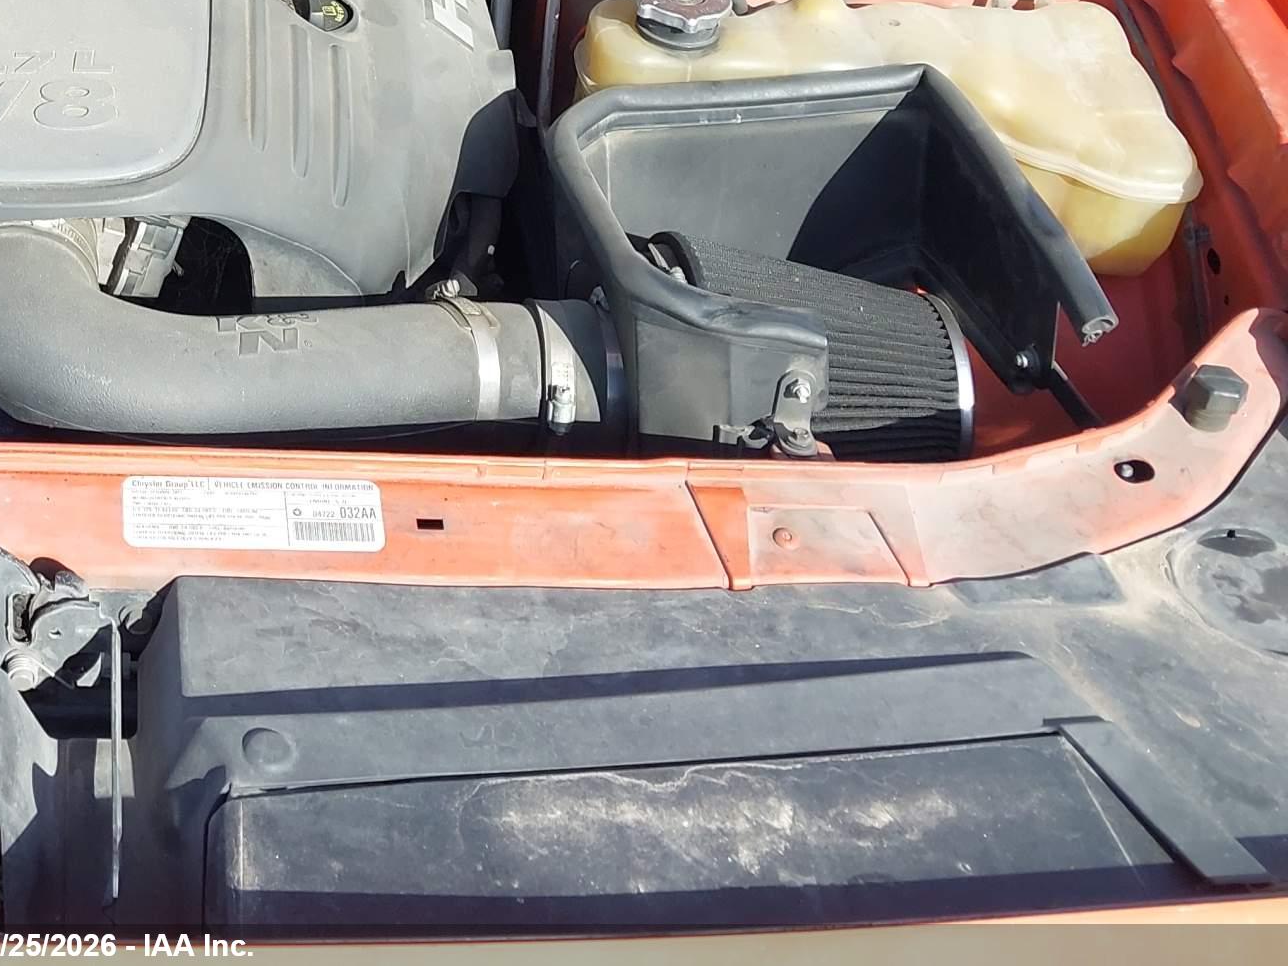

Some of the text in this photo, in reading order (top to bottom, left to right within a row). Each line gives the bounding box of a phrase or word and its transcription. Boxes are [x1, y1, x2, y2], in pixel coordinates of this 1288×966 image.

[165, 480, 188, 490] Group
[214, 481, 374, 492] VEHICLE EMISSION CONTROL INFORMATION
[339, 506, 377, 520] 032AA
